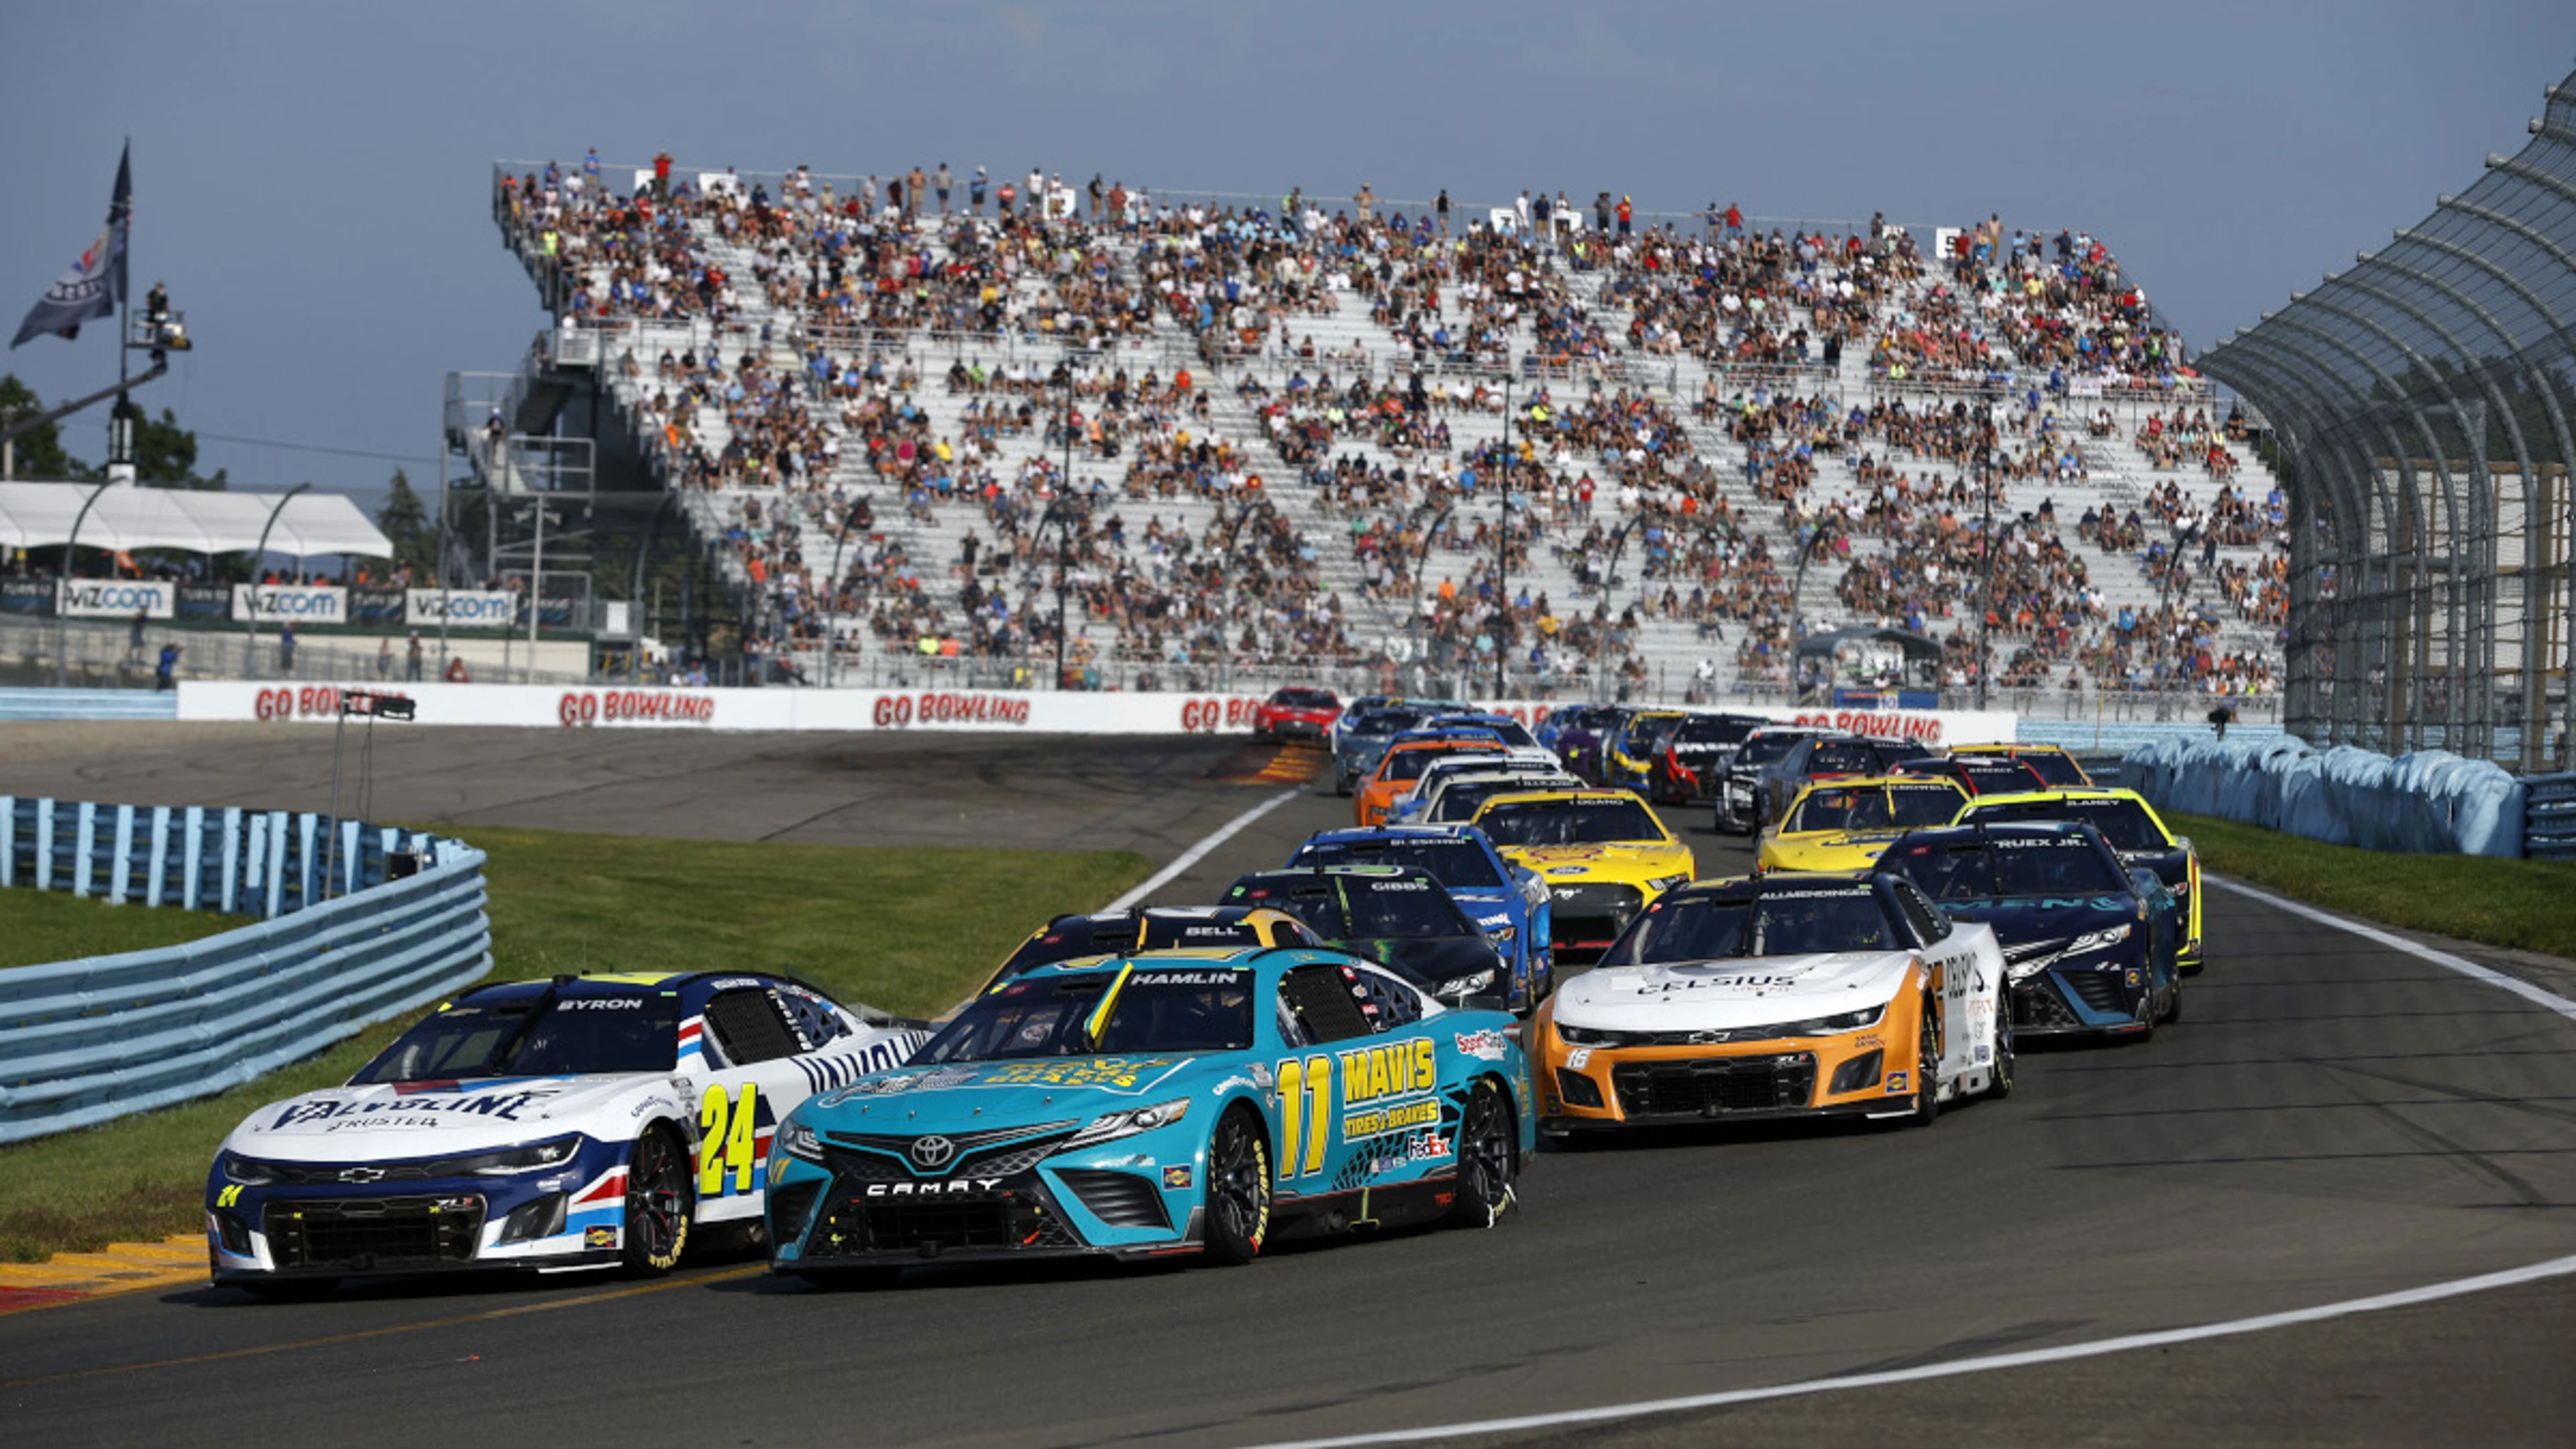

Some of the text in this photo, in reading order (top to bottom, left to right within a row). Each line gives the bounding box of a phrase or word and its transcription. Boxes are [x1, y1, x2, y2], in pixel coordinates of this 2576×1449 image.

[256, 688, 292, 721] GO
[559, 690, 715, 727] GO BOWLING
[874, 693, 1030, 727] GO BOWLING
[1182, 699, 1220, 732] GO
[1836, 712, 1940, 741] BOWLING
[1371, 881, 1430, 892] GIBBS
[1185, 926, 1240, 936] BELL
[1130, 973, 1238, 986] HAMLIN
[1637, 976, 1795, 995] CELSIUS
[557, 999, 643, 1012] BYRON
[1342, 1039, 1434, 1102] MAVIS
[1565, 1048, 1593, 1069] 16
[270, 1090, 561, 1132] VALVOLINE
[1276, 1054, 1333, 1181] 11
[1345, 1113, 1379, 1138] TIRES
[1388, 1101, 1438, 1128] BRAKES
[699, 1081, 757, 1195] 24
[1409, 1133, 1450, 1161] FedEx
[215, 1184, 246, 1208] 24
[866, 1178, 1004, 1197] CAMRY
